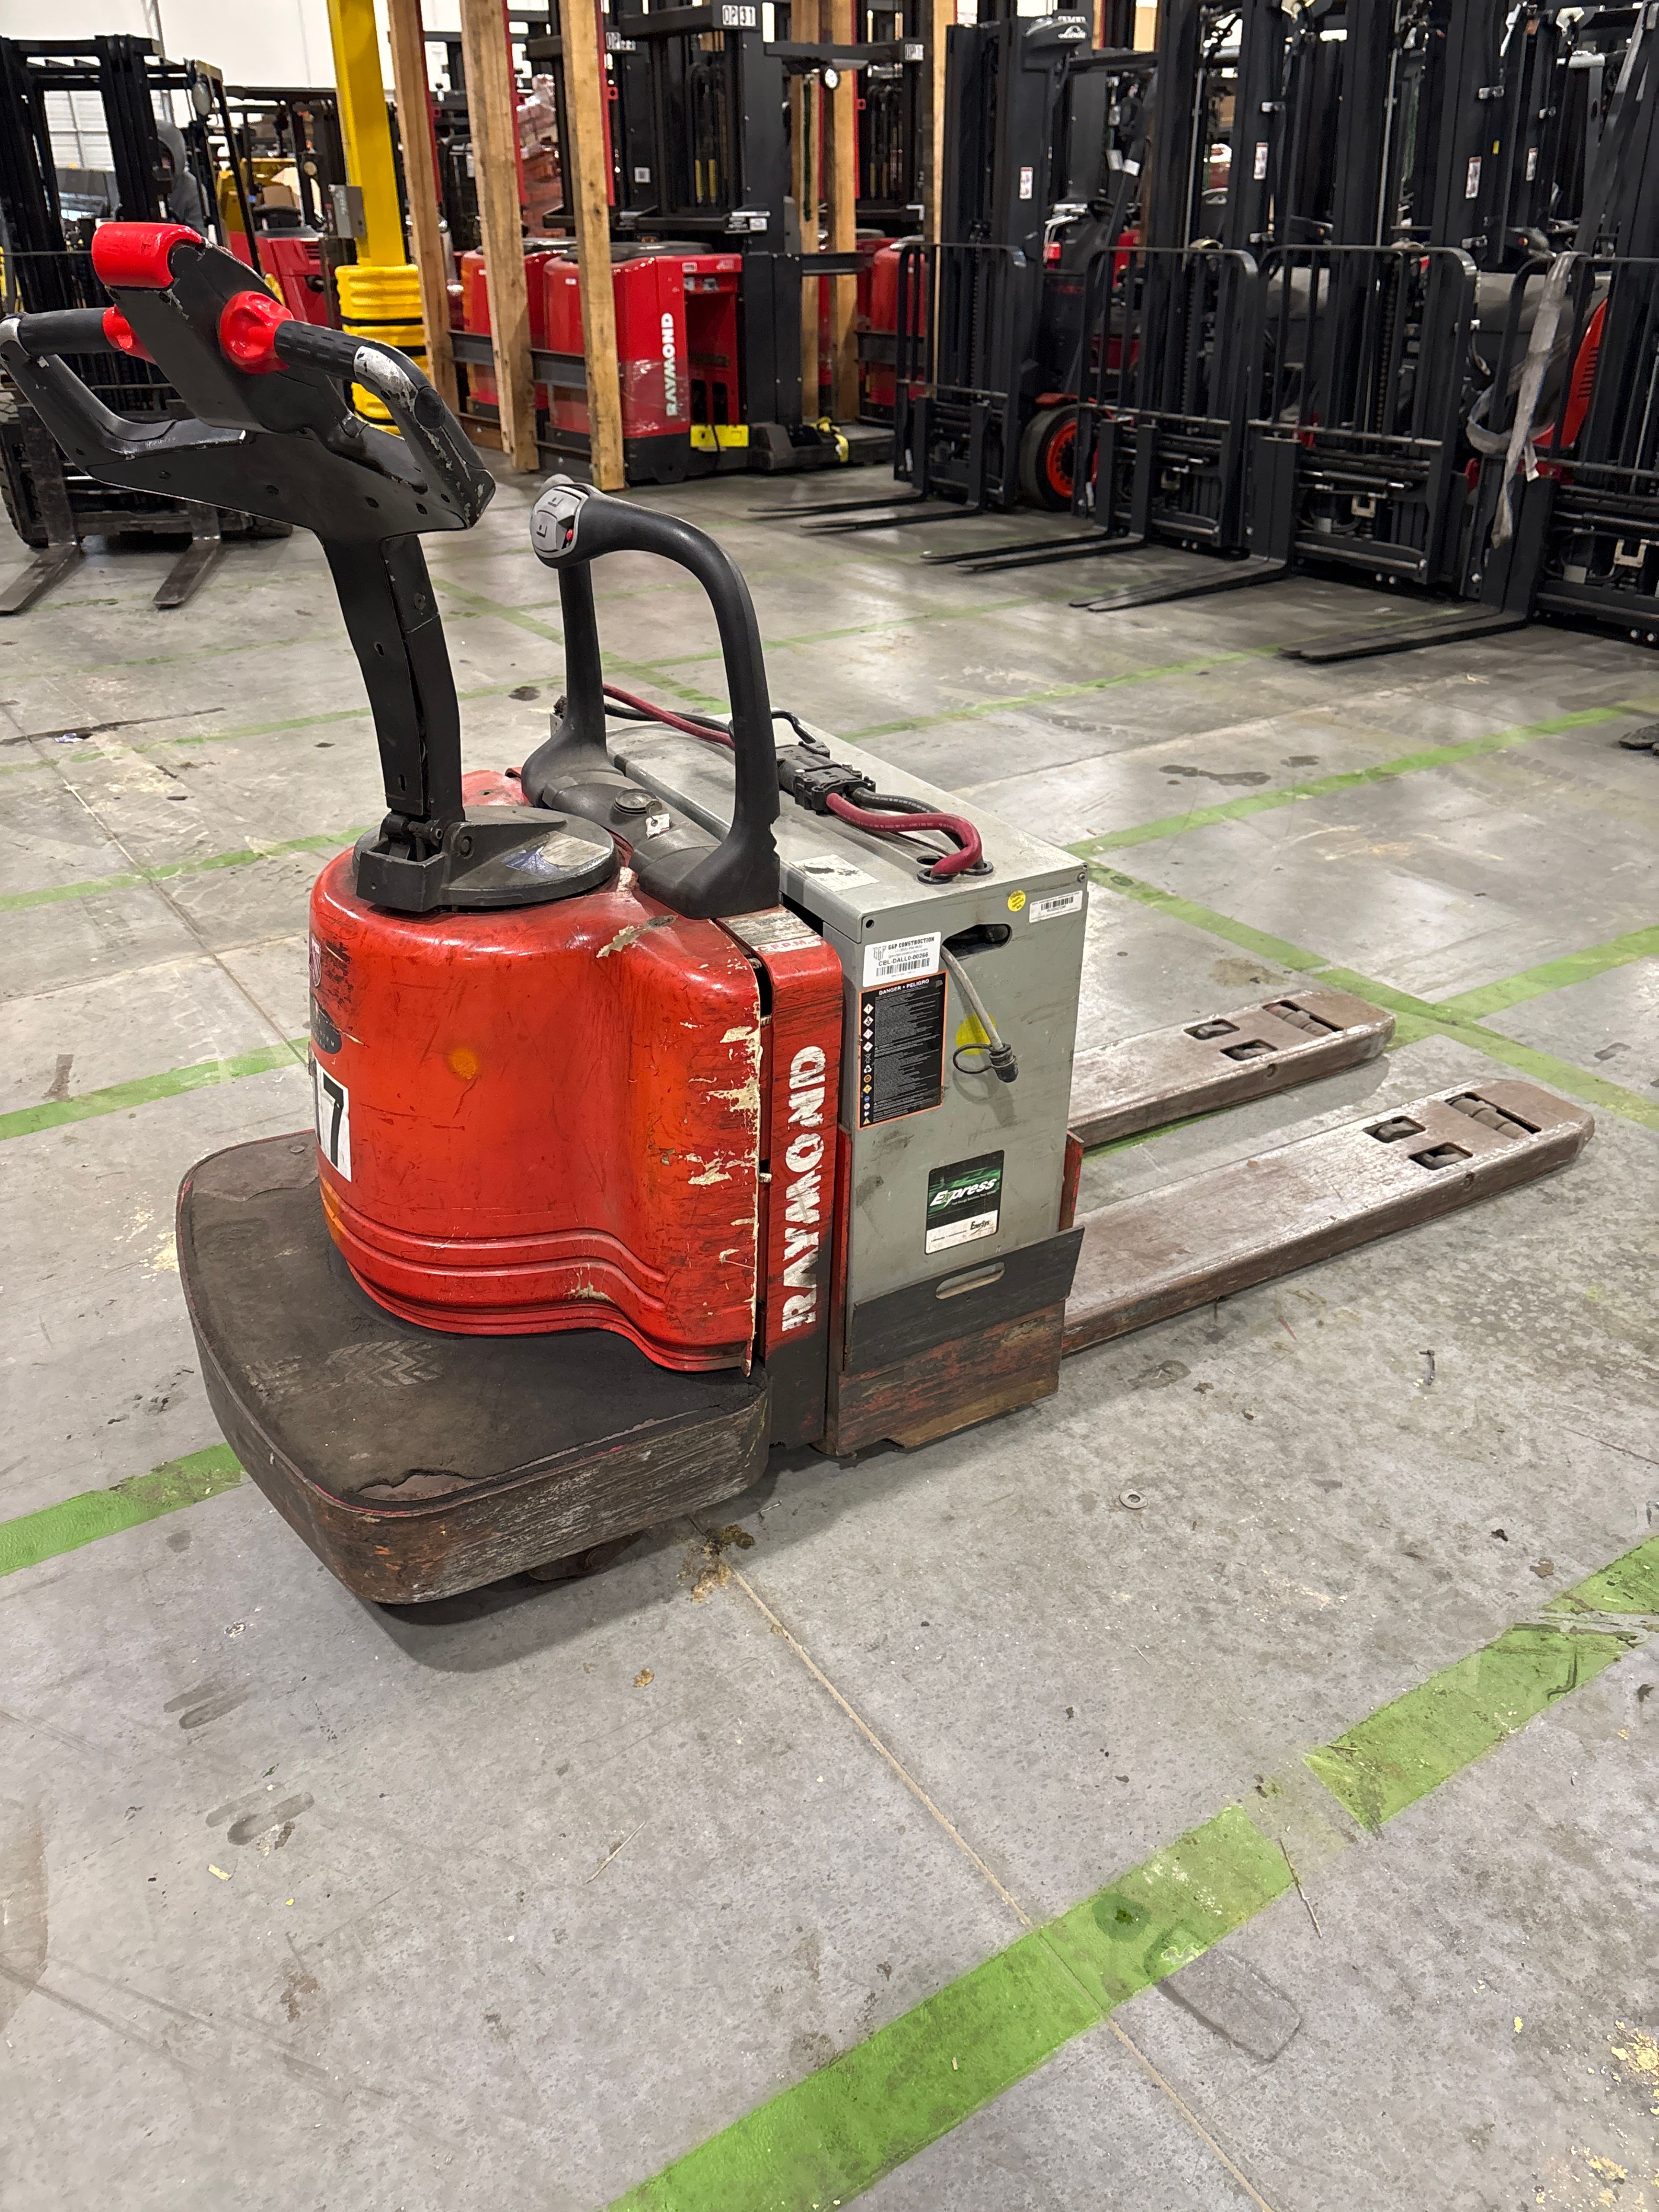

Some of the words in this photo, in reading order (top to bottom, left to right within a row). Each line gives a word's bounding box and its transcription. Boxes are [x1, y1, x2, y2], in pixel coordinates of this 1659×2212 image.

[661, 312, 678, 417] RAYMOND
[899, 936, 934, 948] CONSTRUCTION
[879, 986, 901, 995] DANGER
[906, 979, 930, 989] PELIGRO
[782, 1046, 827, 1332] RAYMOND
[929, 1178, 997, 1209] Express
